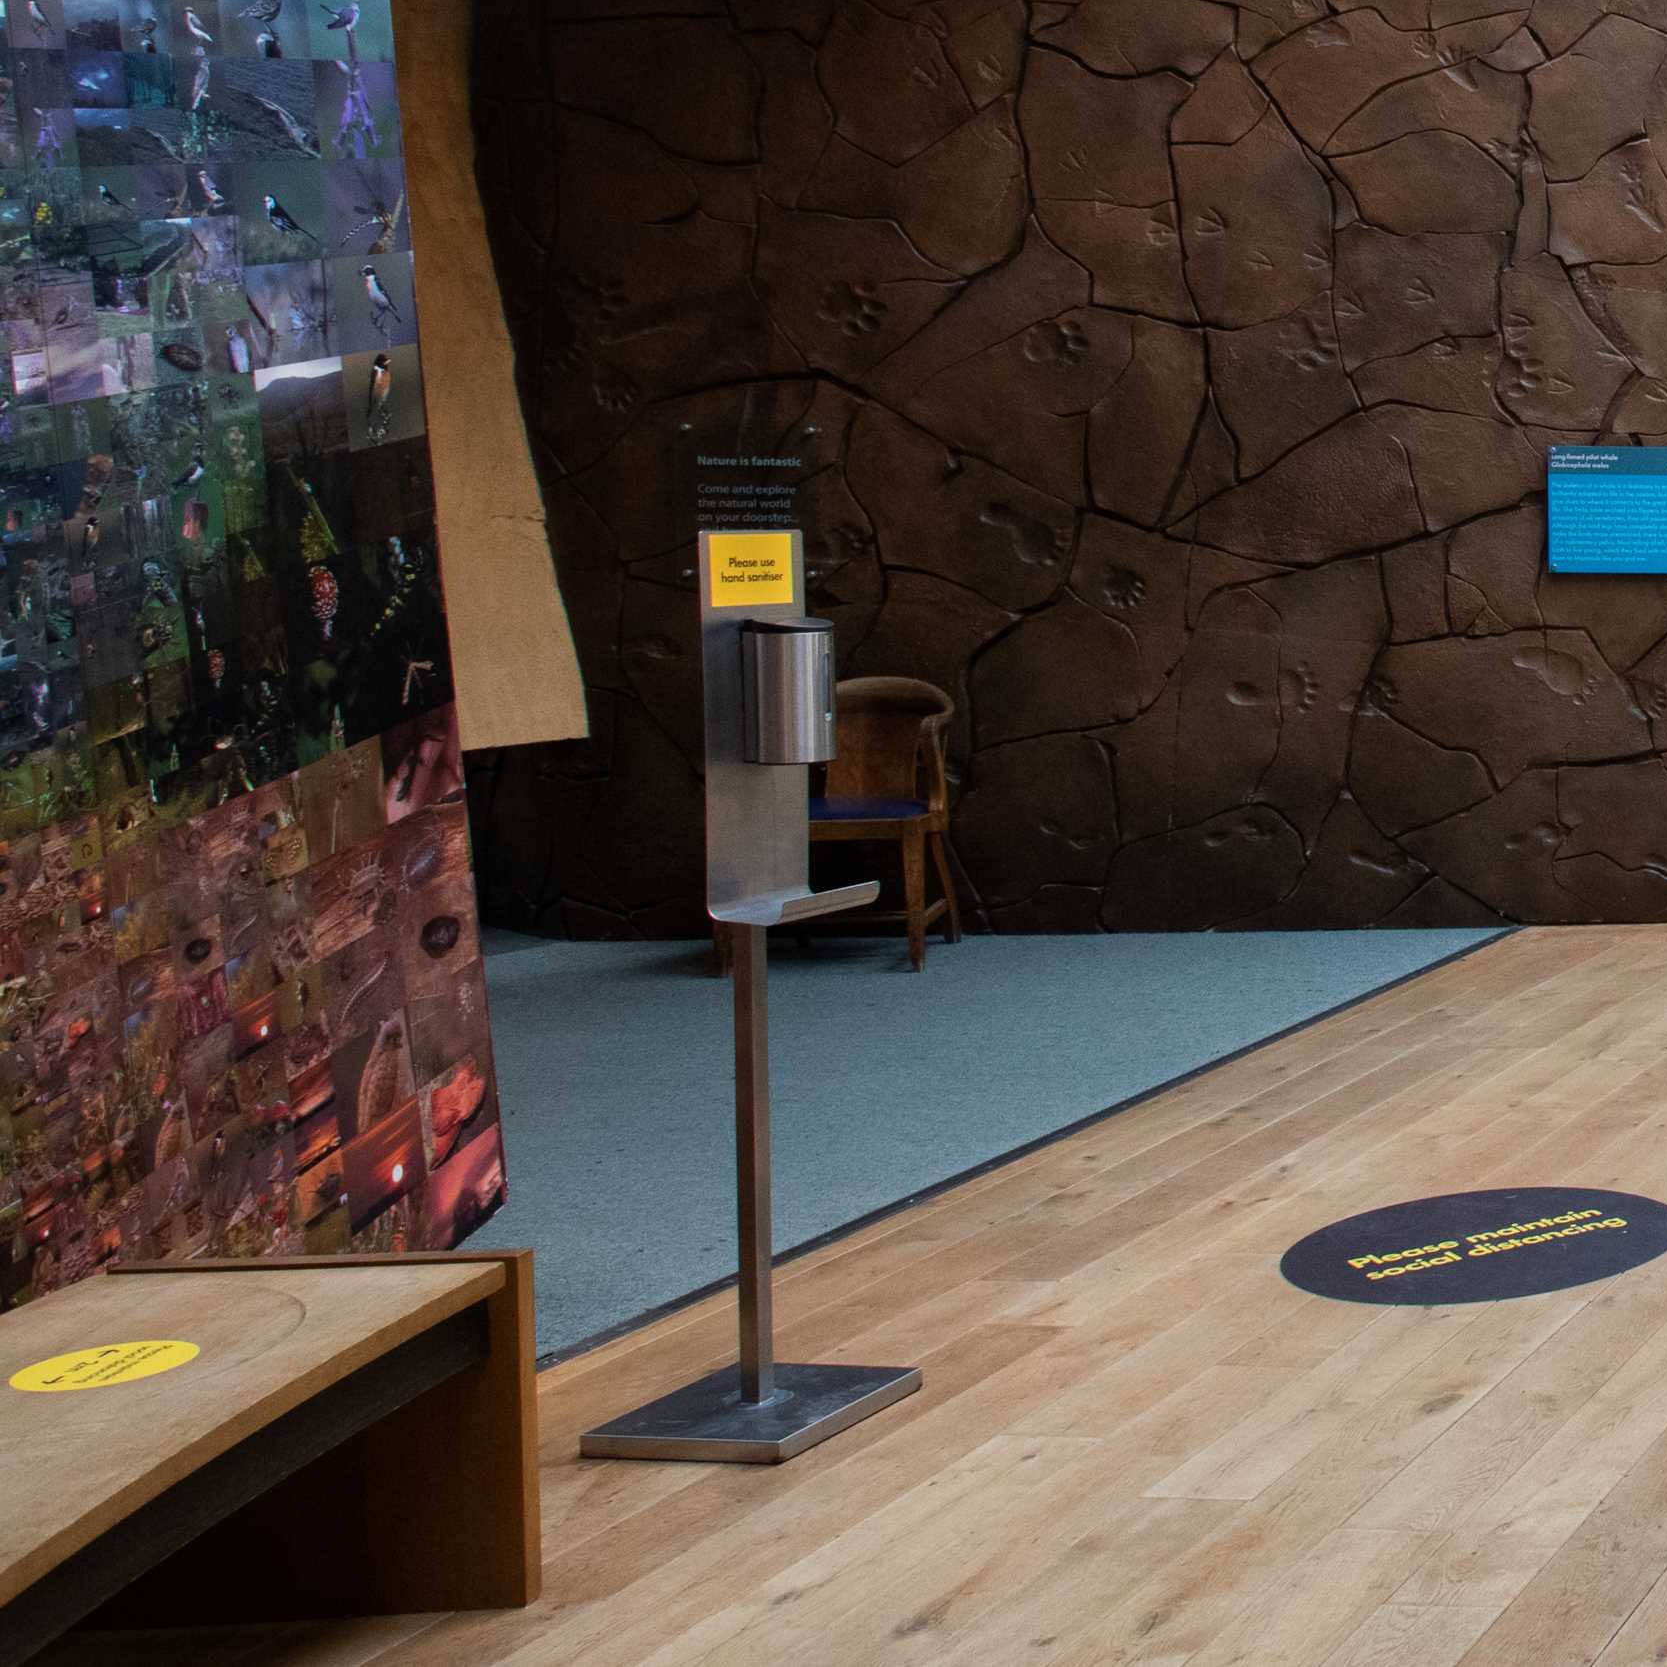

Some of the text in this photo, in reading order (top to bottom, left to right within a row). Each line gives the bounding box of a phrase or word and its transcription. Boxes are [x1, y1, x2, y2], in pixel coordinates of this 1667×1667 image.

[697, 455, 802, 468] Nature is fantastic
[697, 483, 797, 497] Come and explore
[698, 497, 791, 509] the natural world
[698, 512, 713, 522] on
[715, 512, 740, 524] your
[728, 557, 776, 568] Please use
[721, 571, 784, 583] hand sanitiser
[1347, 1209, 1603, 1271] Please maintain
[1366, 1216, 1628, 1281] social distancing
